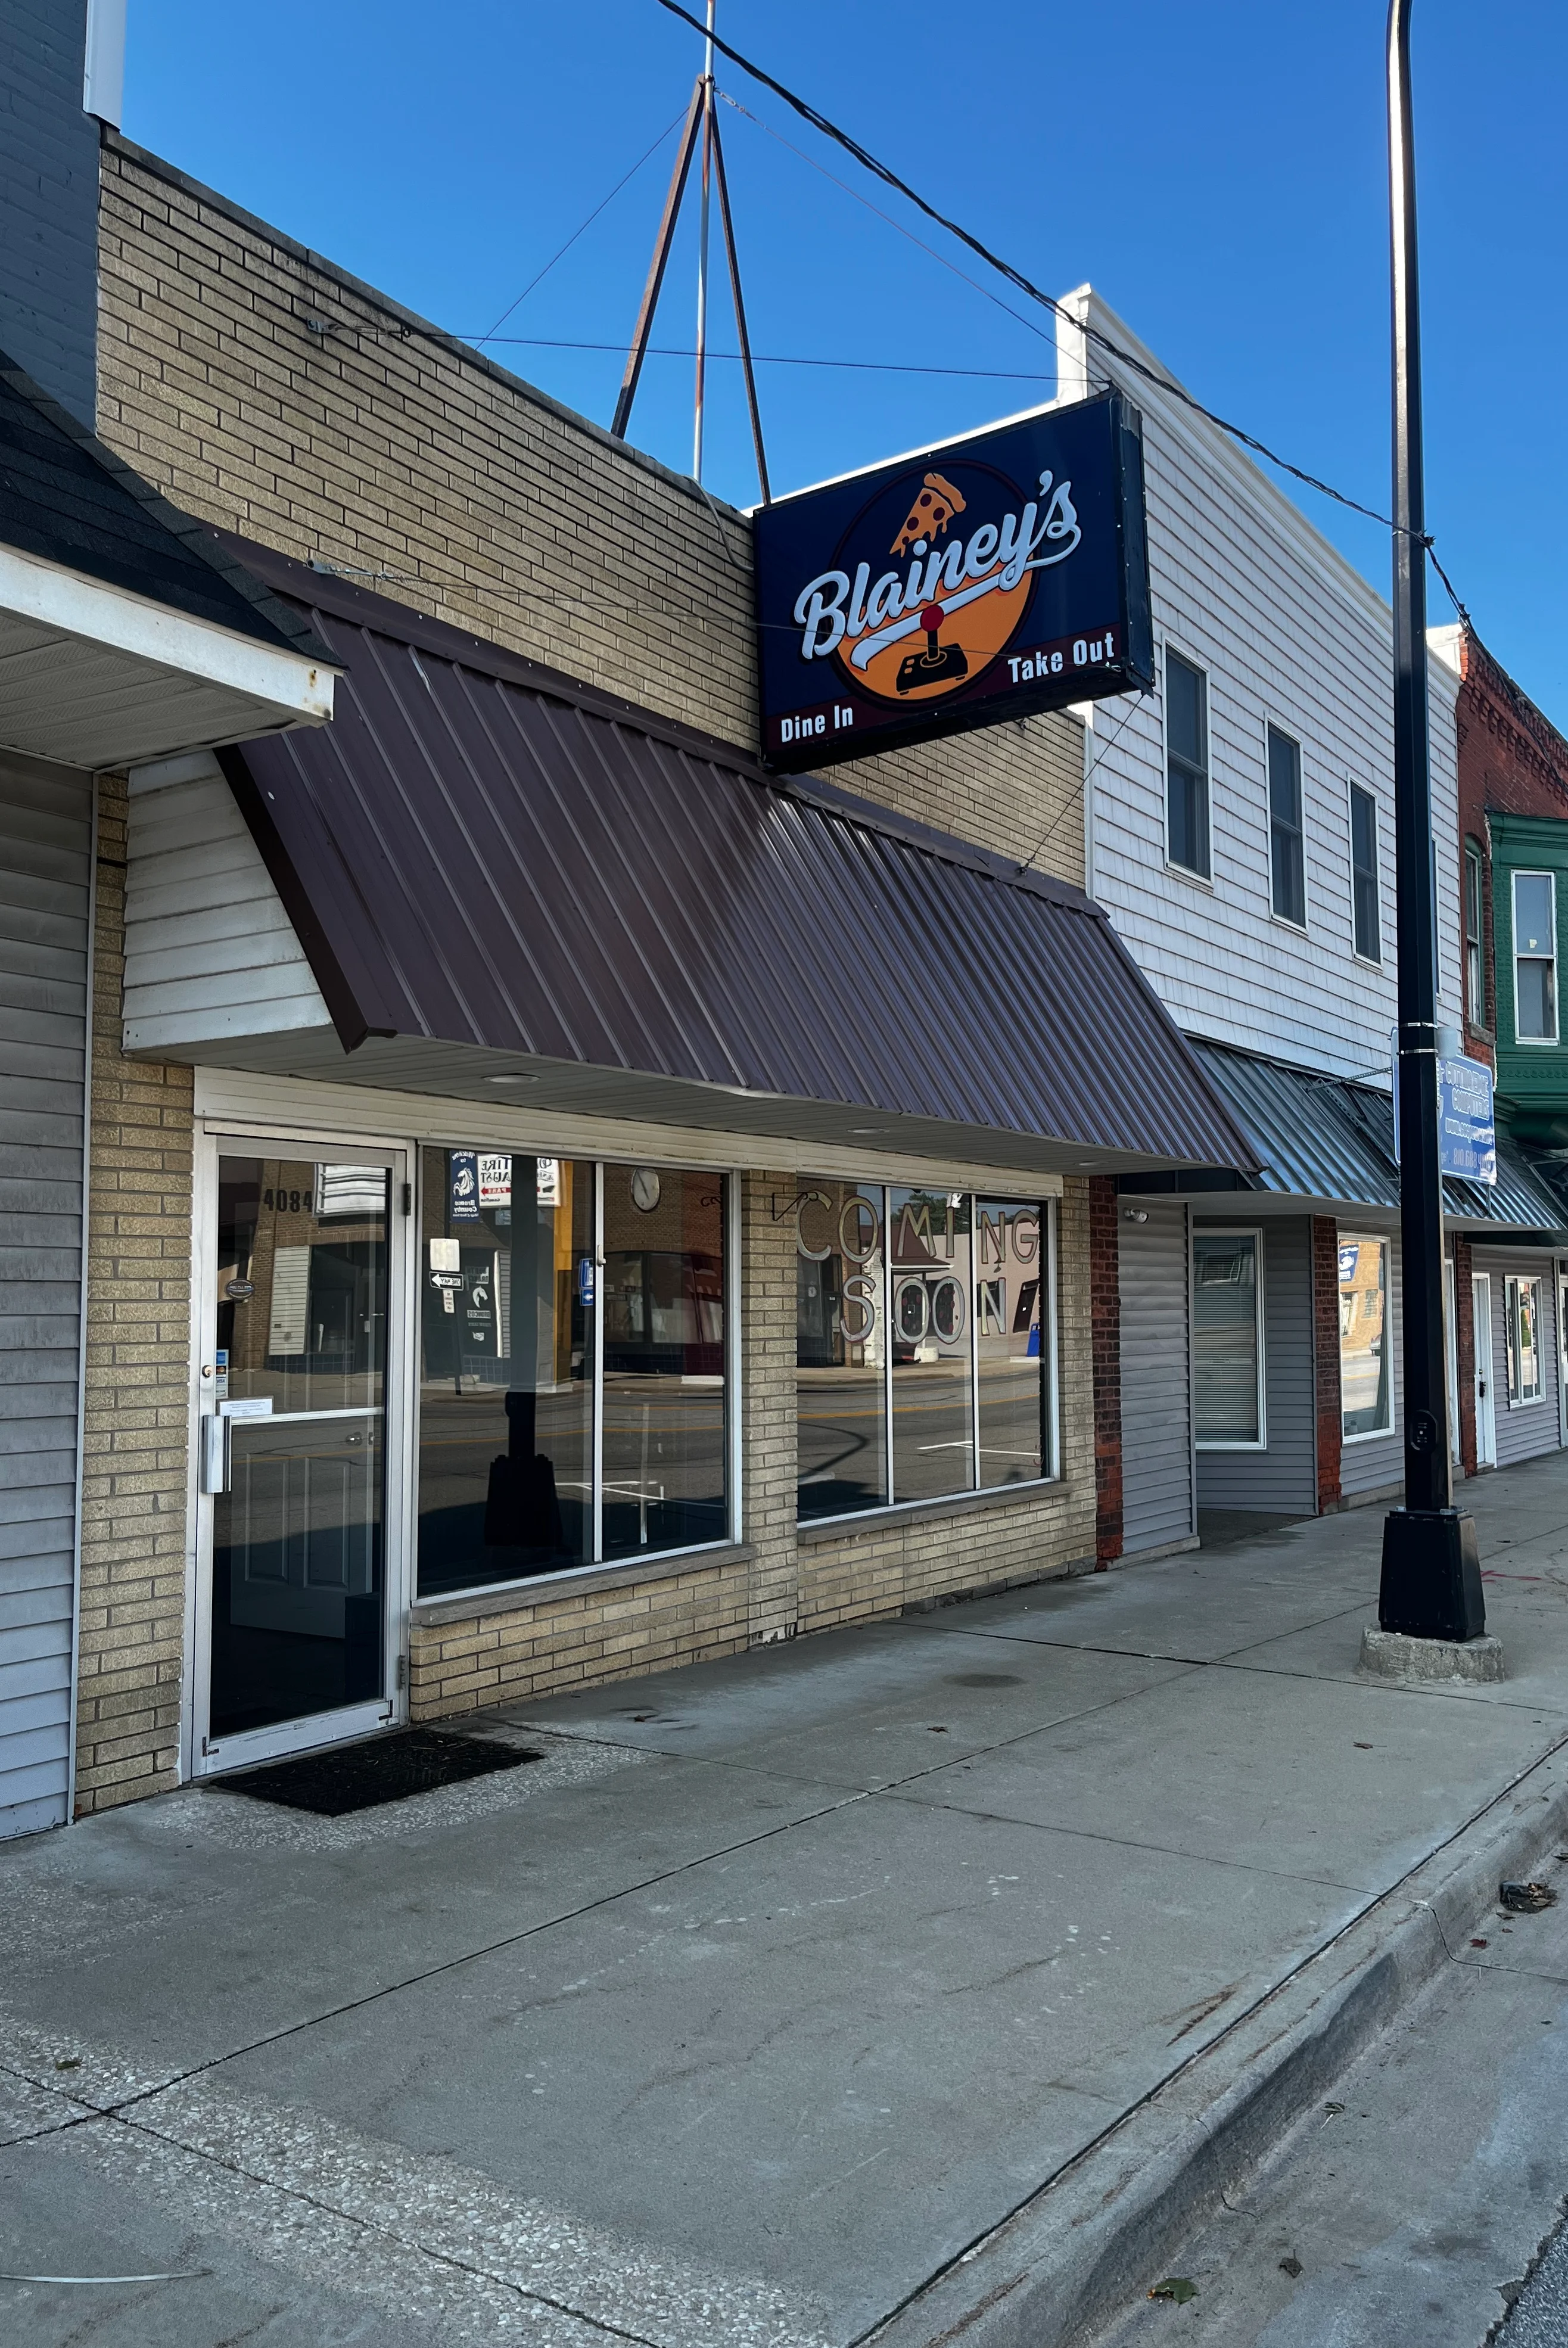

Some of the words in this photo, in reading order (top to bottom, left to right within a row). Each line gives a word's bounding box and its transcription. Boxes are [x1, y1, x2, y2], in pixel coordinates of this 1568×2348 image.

[794, 470, 1082, 661] Blainey's
[1007, 652, 1064, 683] Take
[1073, 632, 1115, 666] Out
[780, 713, 826, 743] Dine
[834, 705, 854, 729] In
[264, 1189, 313, 1212] 4084
[797, 1190, 1040, 1265] COMING
[840, 1274, 1007, 1345] SOON
